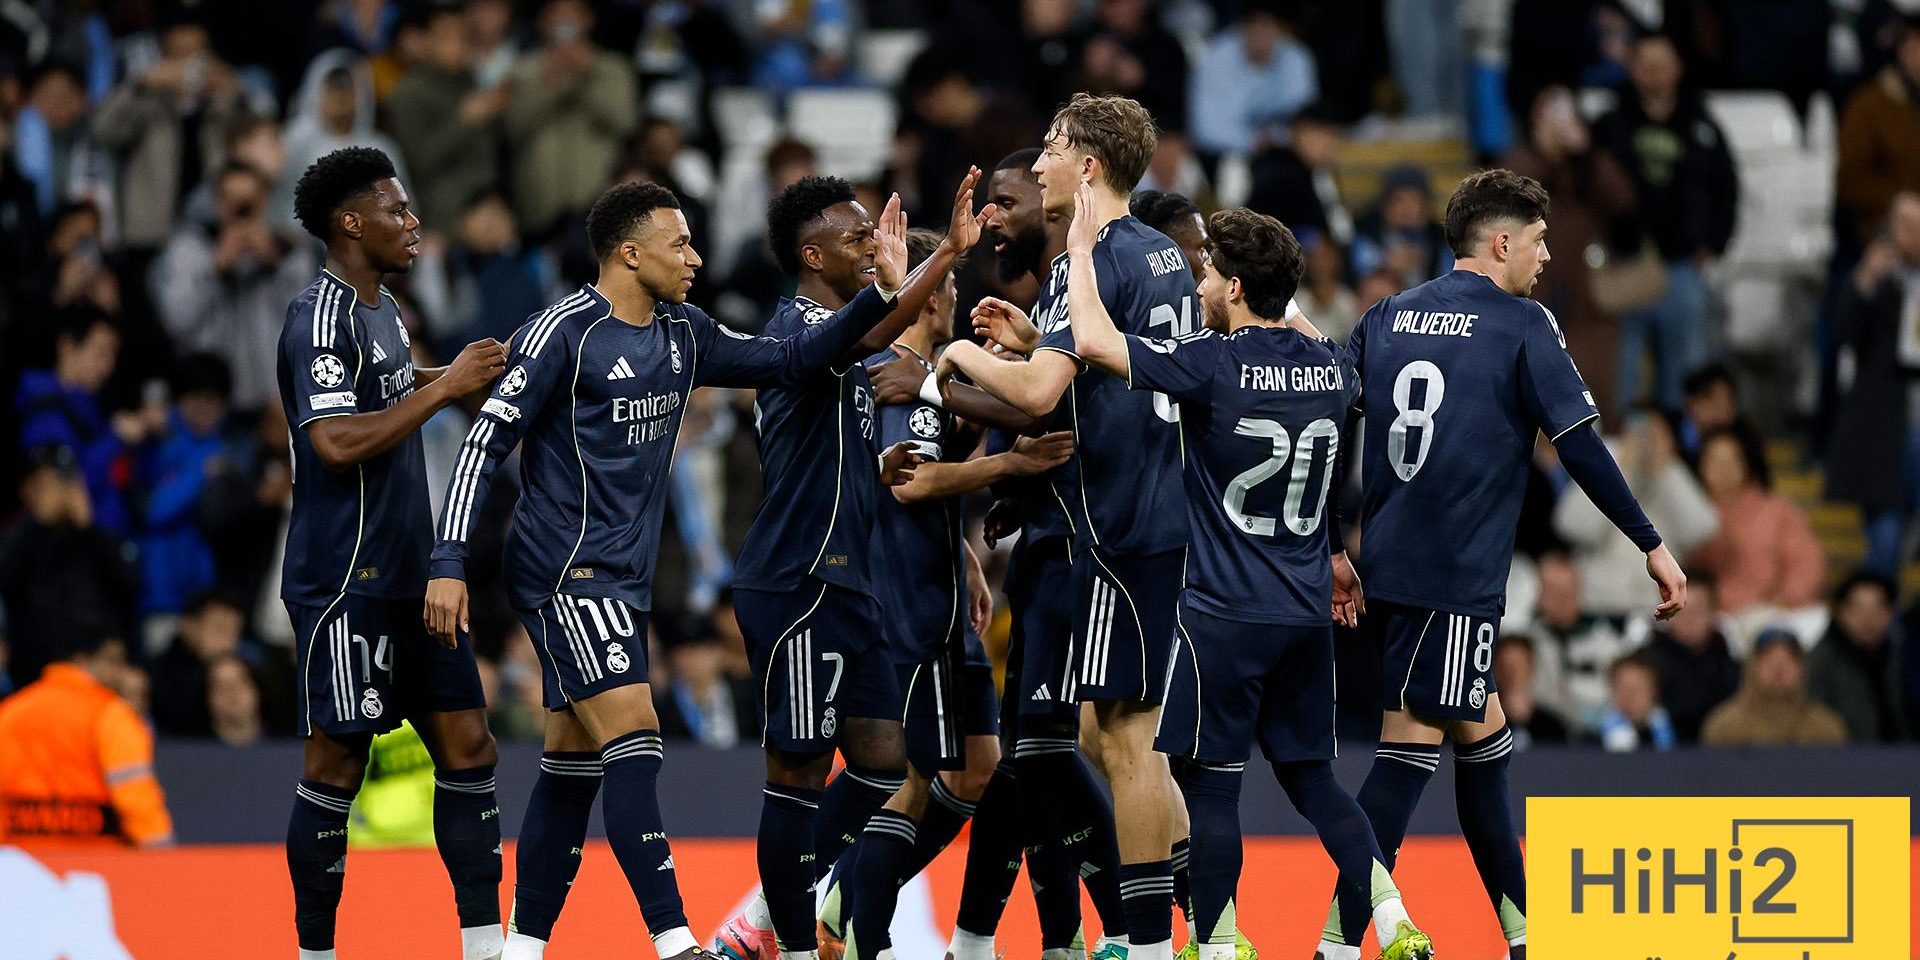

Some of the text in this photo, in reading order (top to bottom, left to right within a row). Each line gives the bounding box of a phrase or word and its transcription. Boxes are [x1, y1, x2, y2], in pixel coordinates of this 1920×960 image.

[1392, 310, 1479, 337] VALVERDE
[1240, 363, 1287, 391] FRAN
[612, 390, 680, 423] Emirates
[1388, 360, 1445, 482] 8
[627, 422, 646, 445] FLY
[1223, 417, 1339, 537] 20
[578, 598, 635, 642] 10
[352, 635, 393, 685] 14
[1474, 622, 1494, 673] 8
[822, 652, 844, 702] 7
